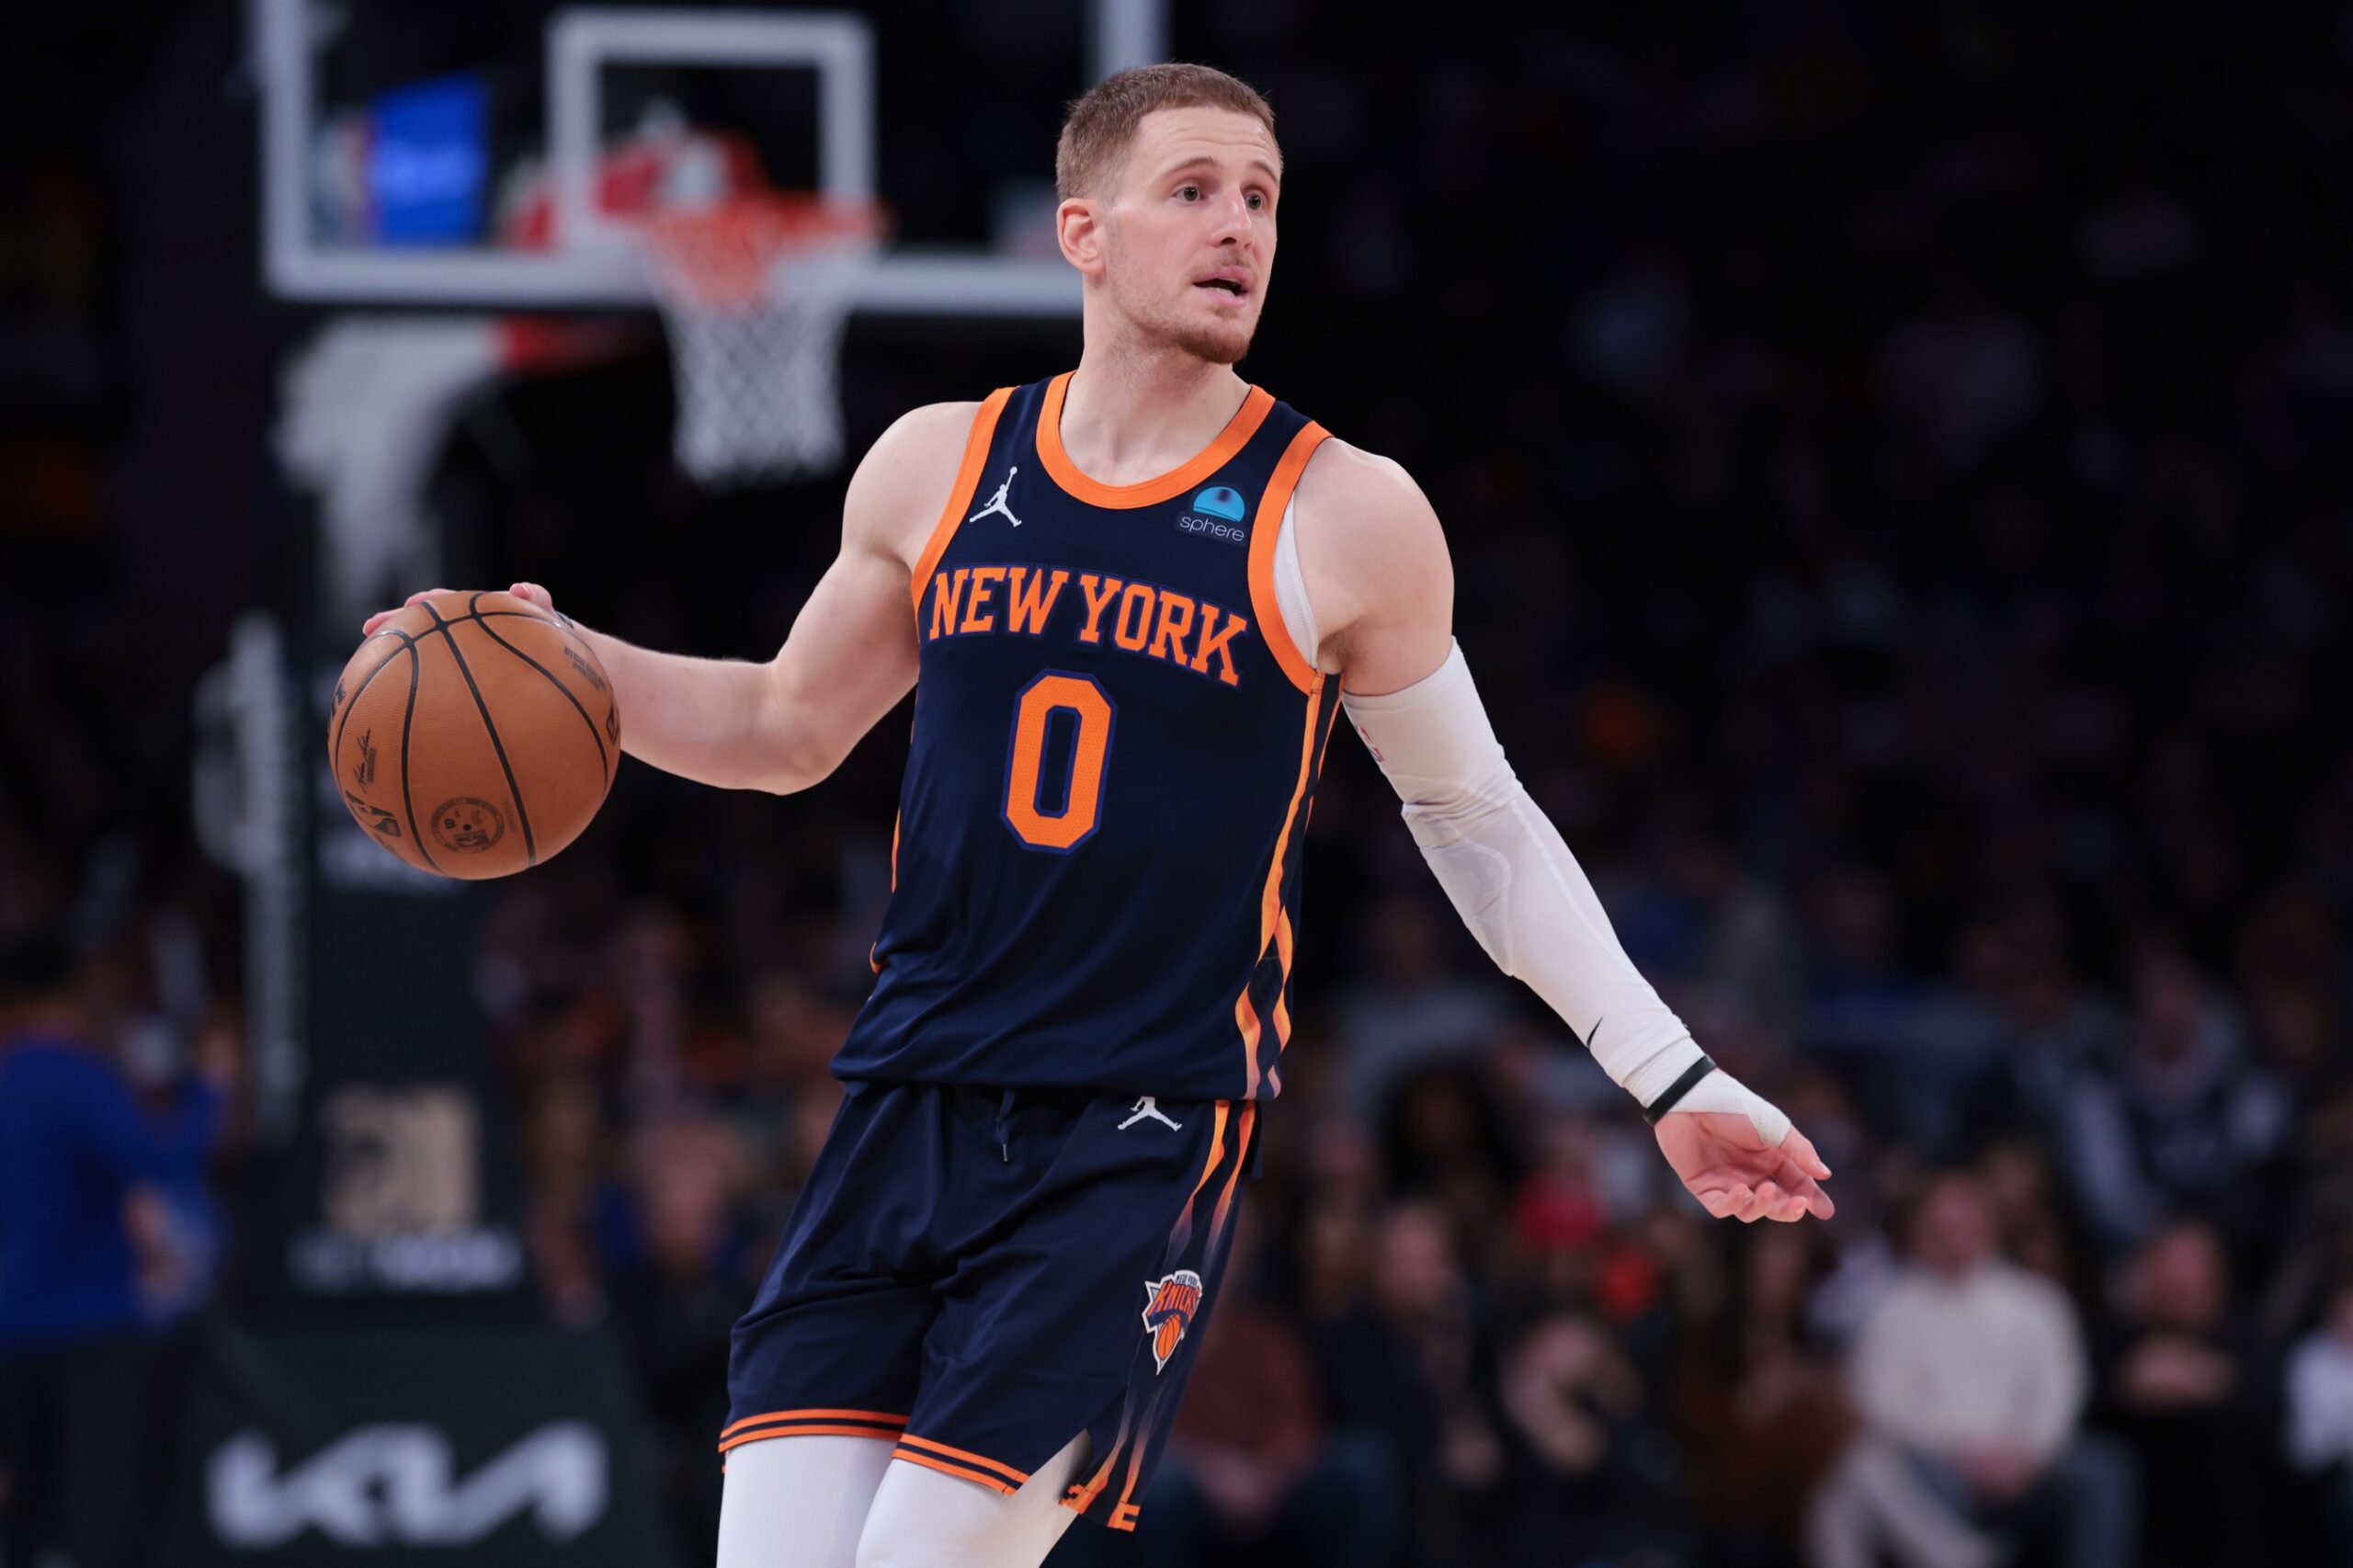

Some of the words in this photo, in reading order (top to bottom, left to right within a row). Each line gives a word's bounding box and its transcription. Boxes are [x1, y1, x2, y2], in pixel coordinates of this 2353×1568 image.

[1179, 517, 1245, 542] sphere
[928, 566, 1070, 641] NEW
[1078, 573, 1248, 687] YORK
[1004, 672, 1115, 852] 0
[1146, 1279, 1201, 1323] KNICKS
